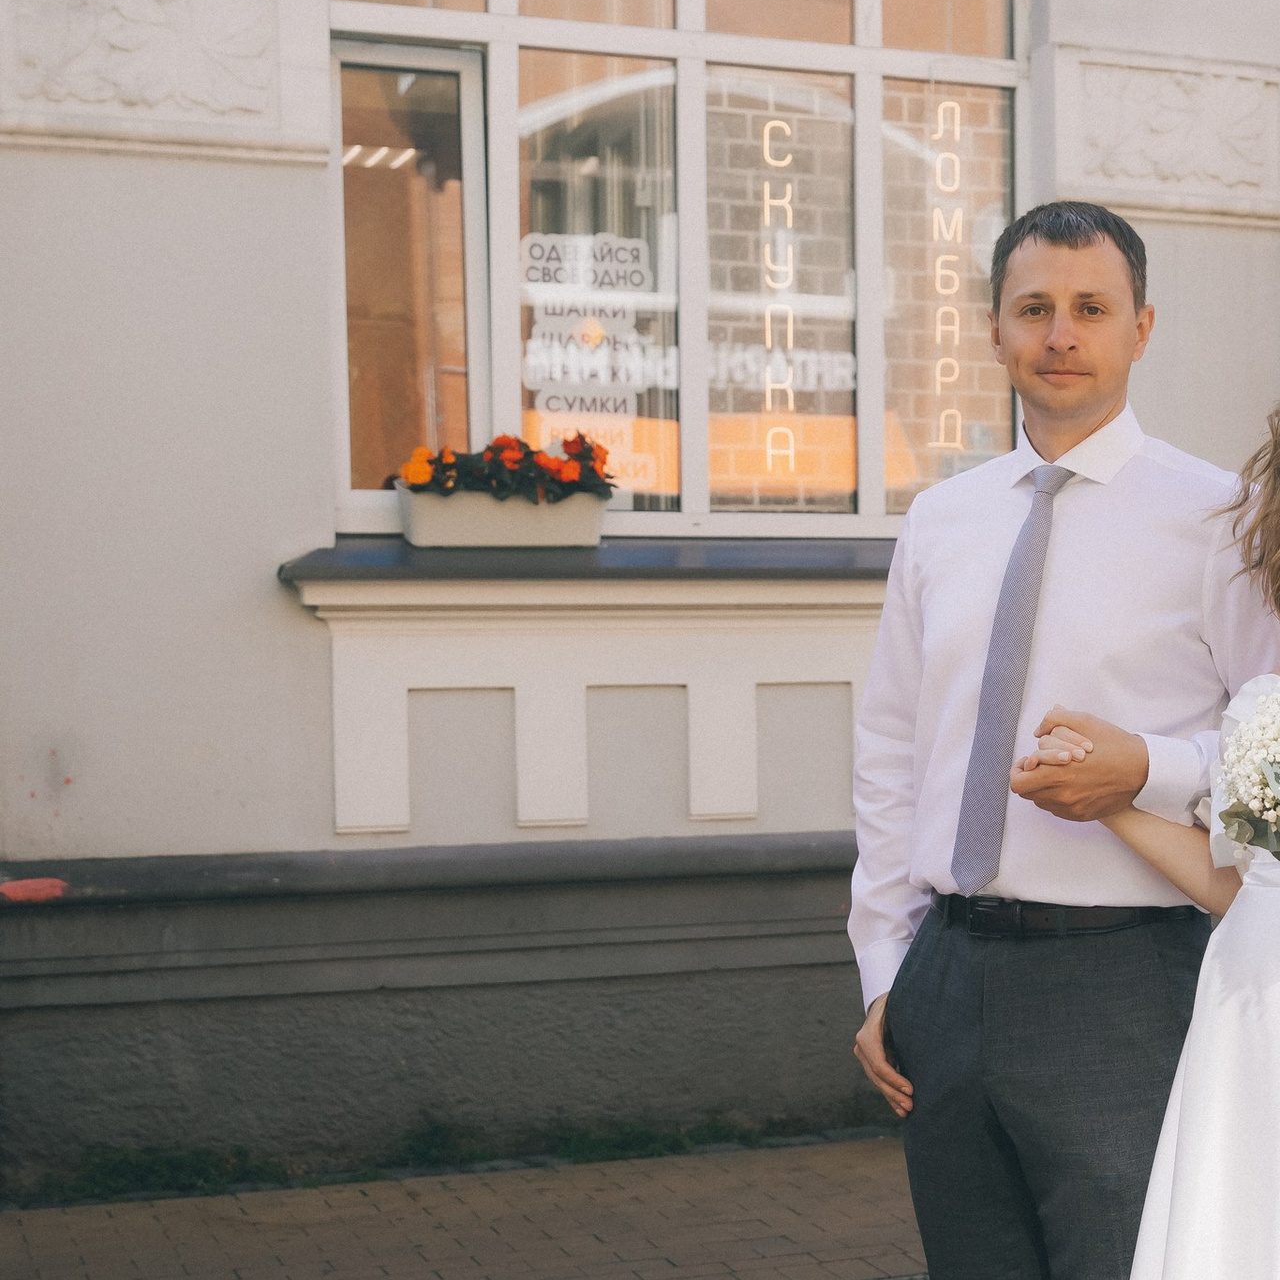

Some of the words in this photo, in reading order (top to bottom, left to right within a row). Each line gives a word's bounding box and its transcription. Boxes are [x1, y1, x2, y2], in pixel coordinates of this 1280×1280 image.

[529, 242, 640, 264] ОДЕАЙСЯ
[762, 119, 796, 473] СКУПКА
[927, 100, 965, 450] ЛОМБАРД
[545, 395, 628, 414] СУМКИ
